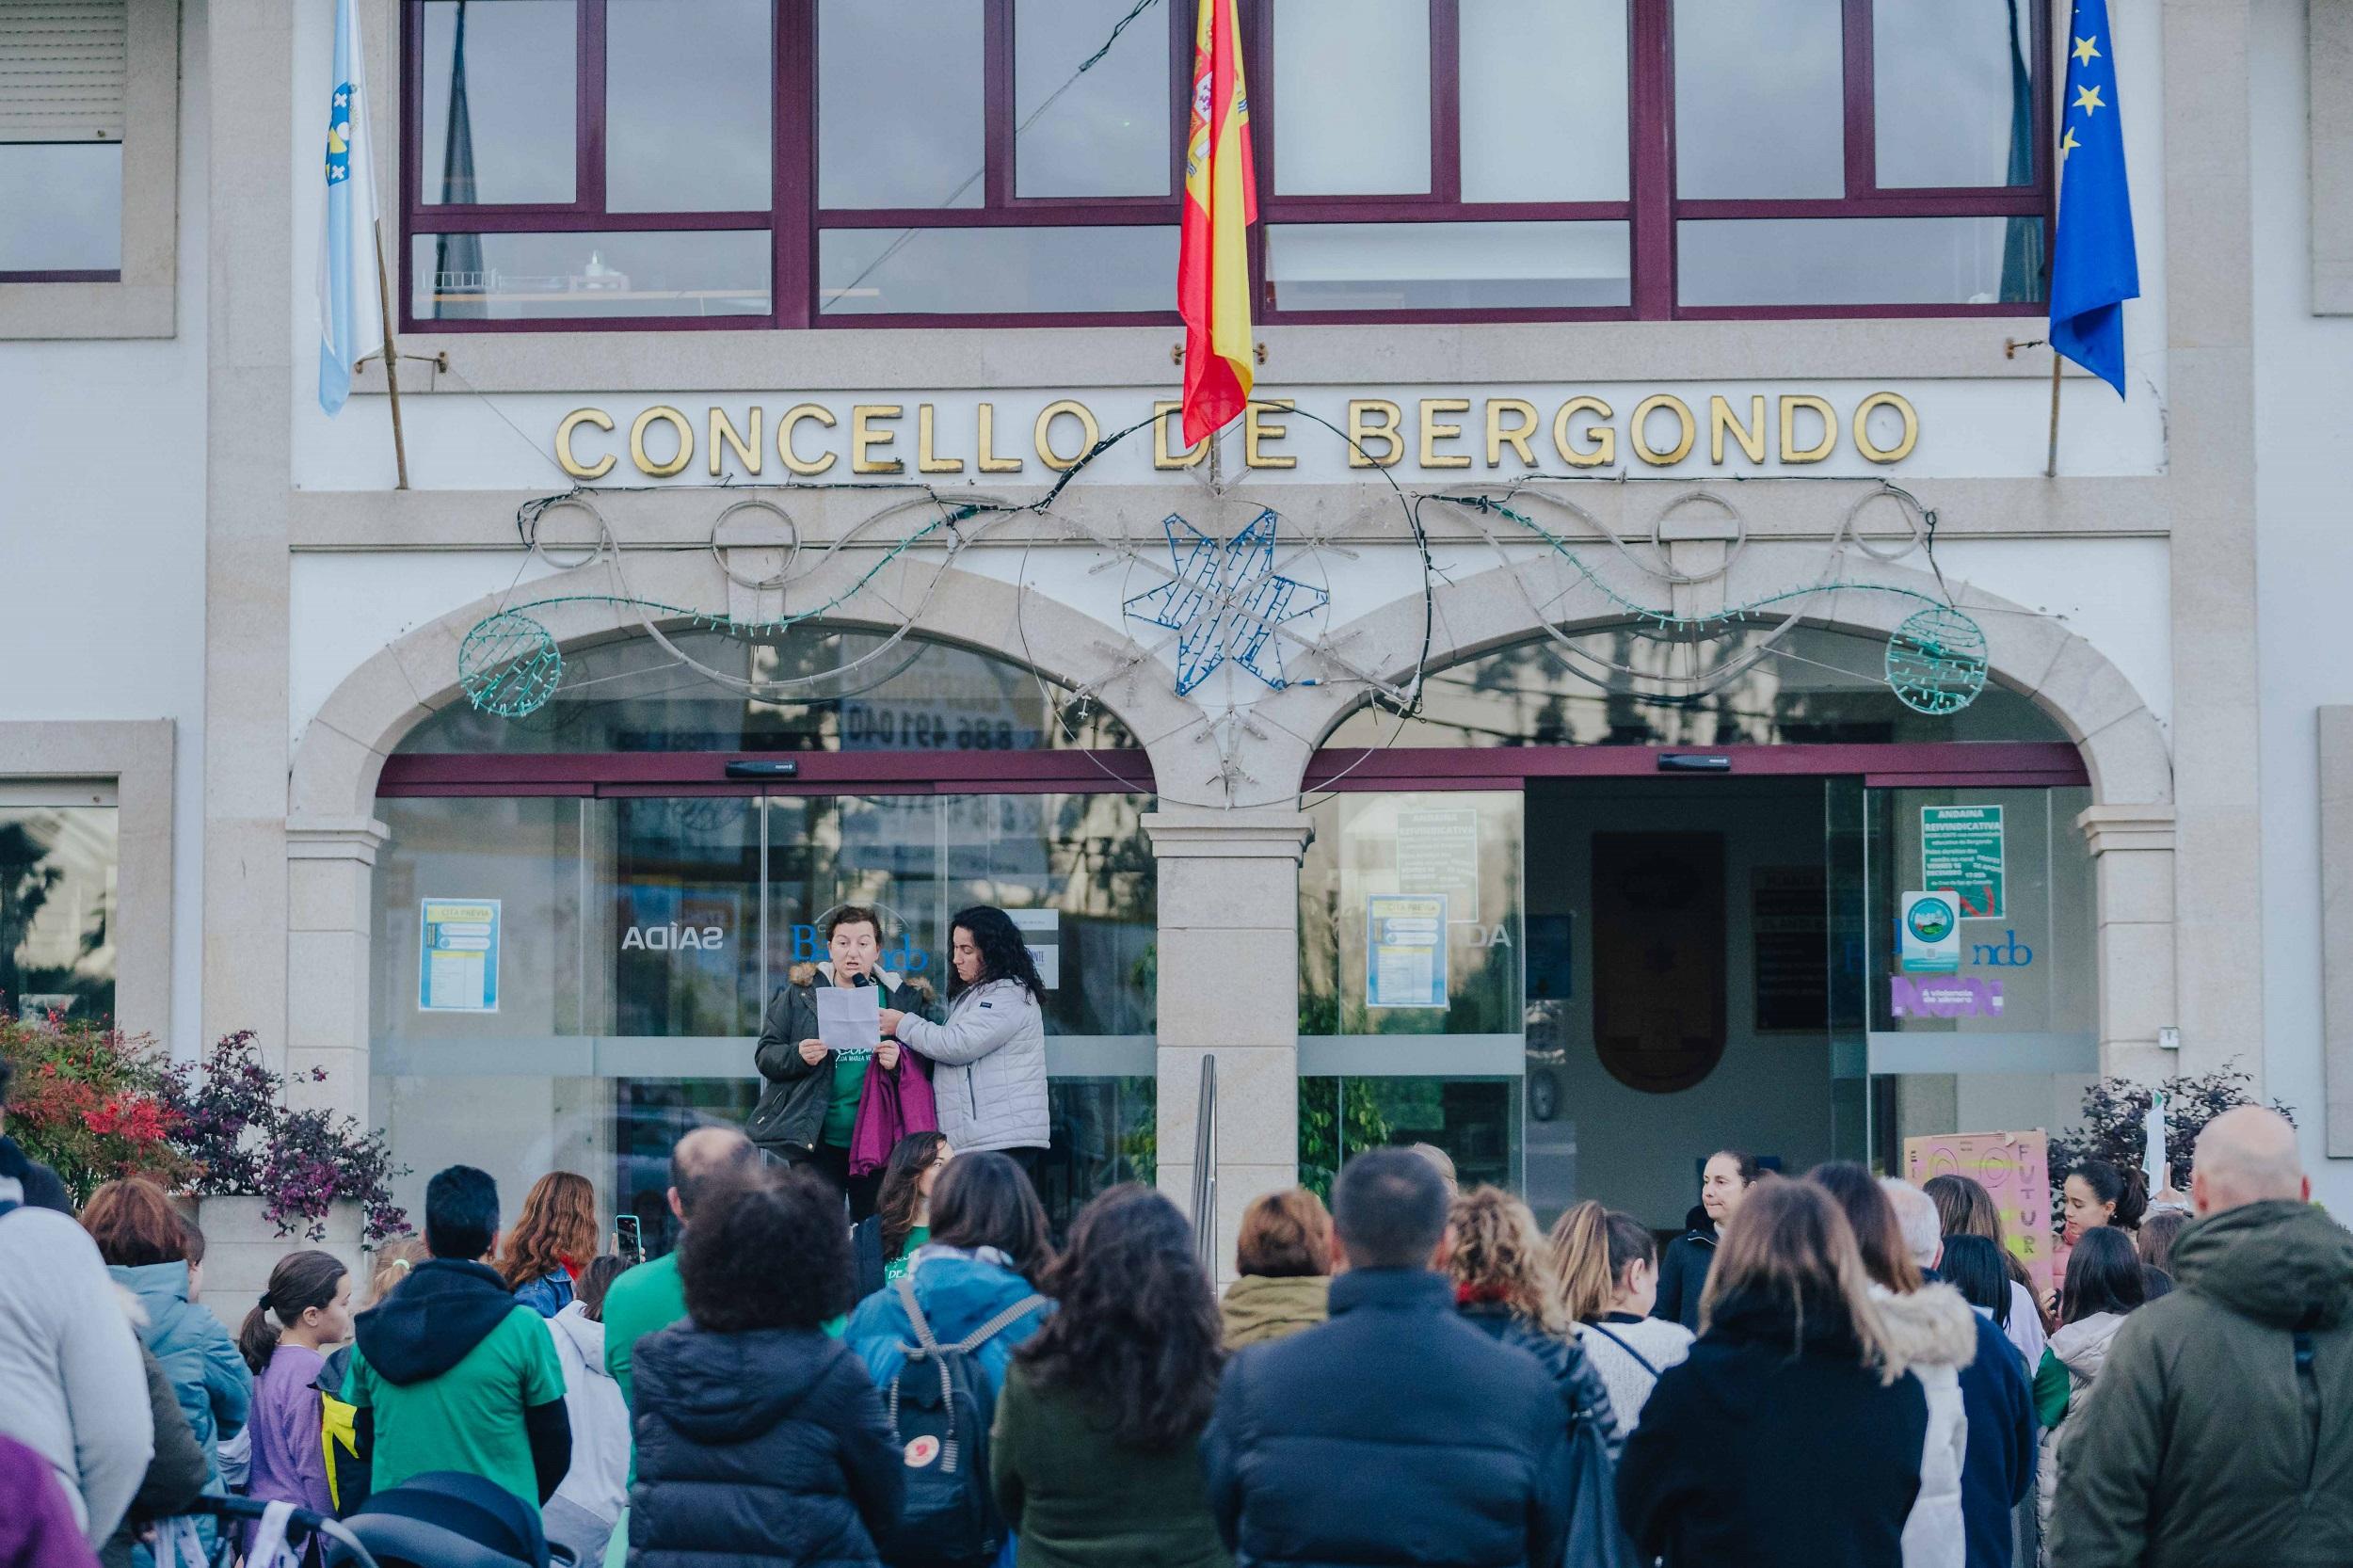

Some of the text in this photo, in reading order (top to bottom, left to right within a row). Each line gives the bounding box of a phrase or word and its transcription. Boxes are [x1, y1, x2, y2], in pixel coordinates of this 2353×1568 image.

[554, 392, 1919, 479] CONCELLO DE BERGONDO
